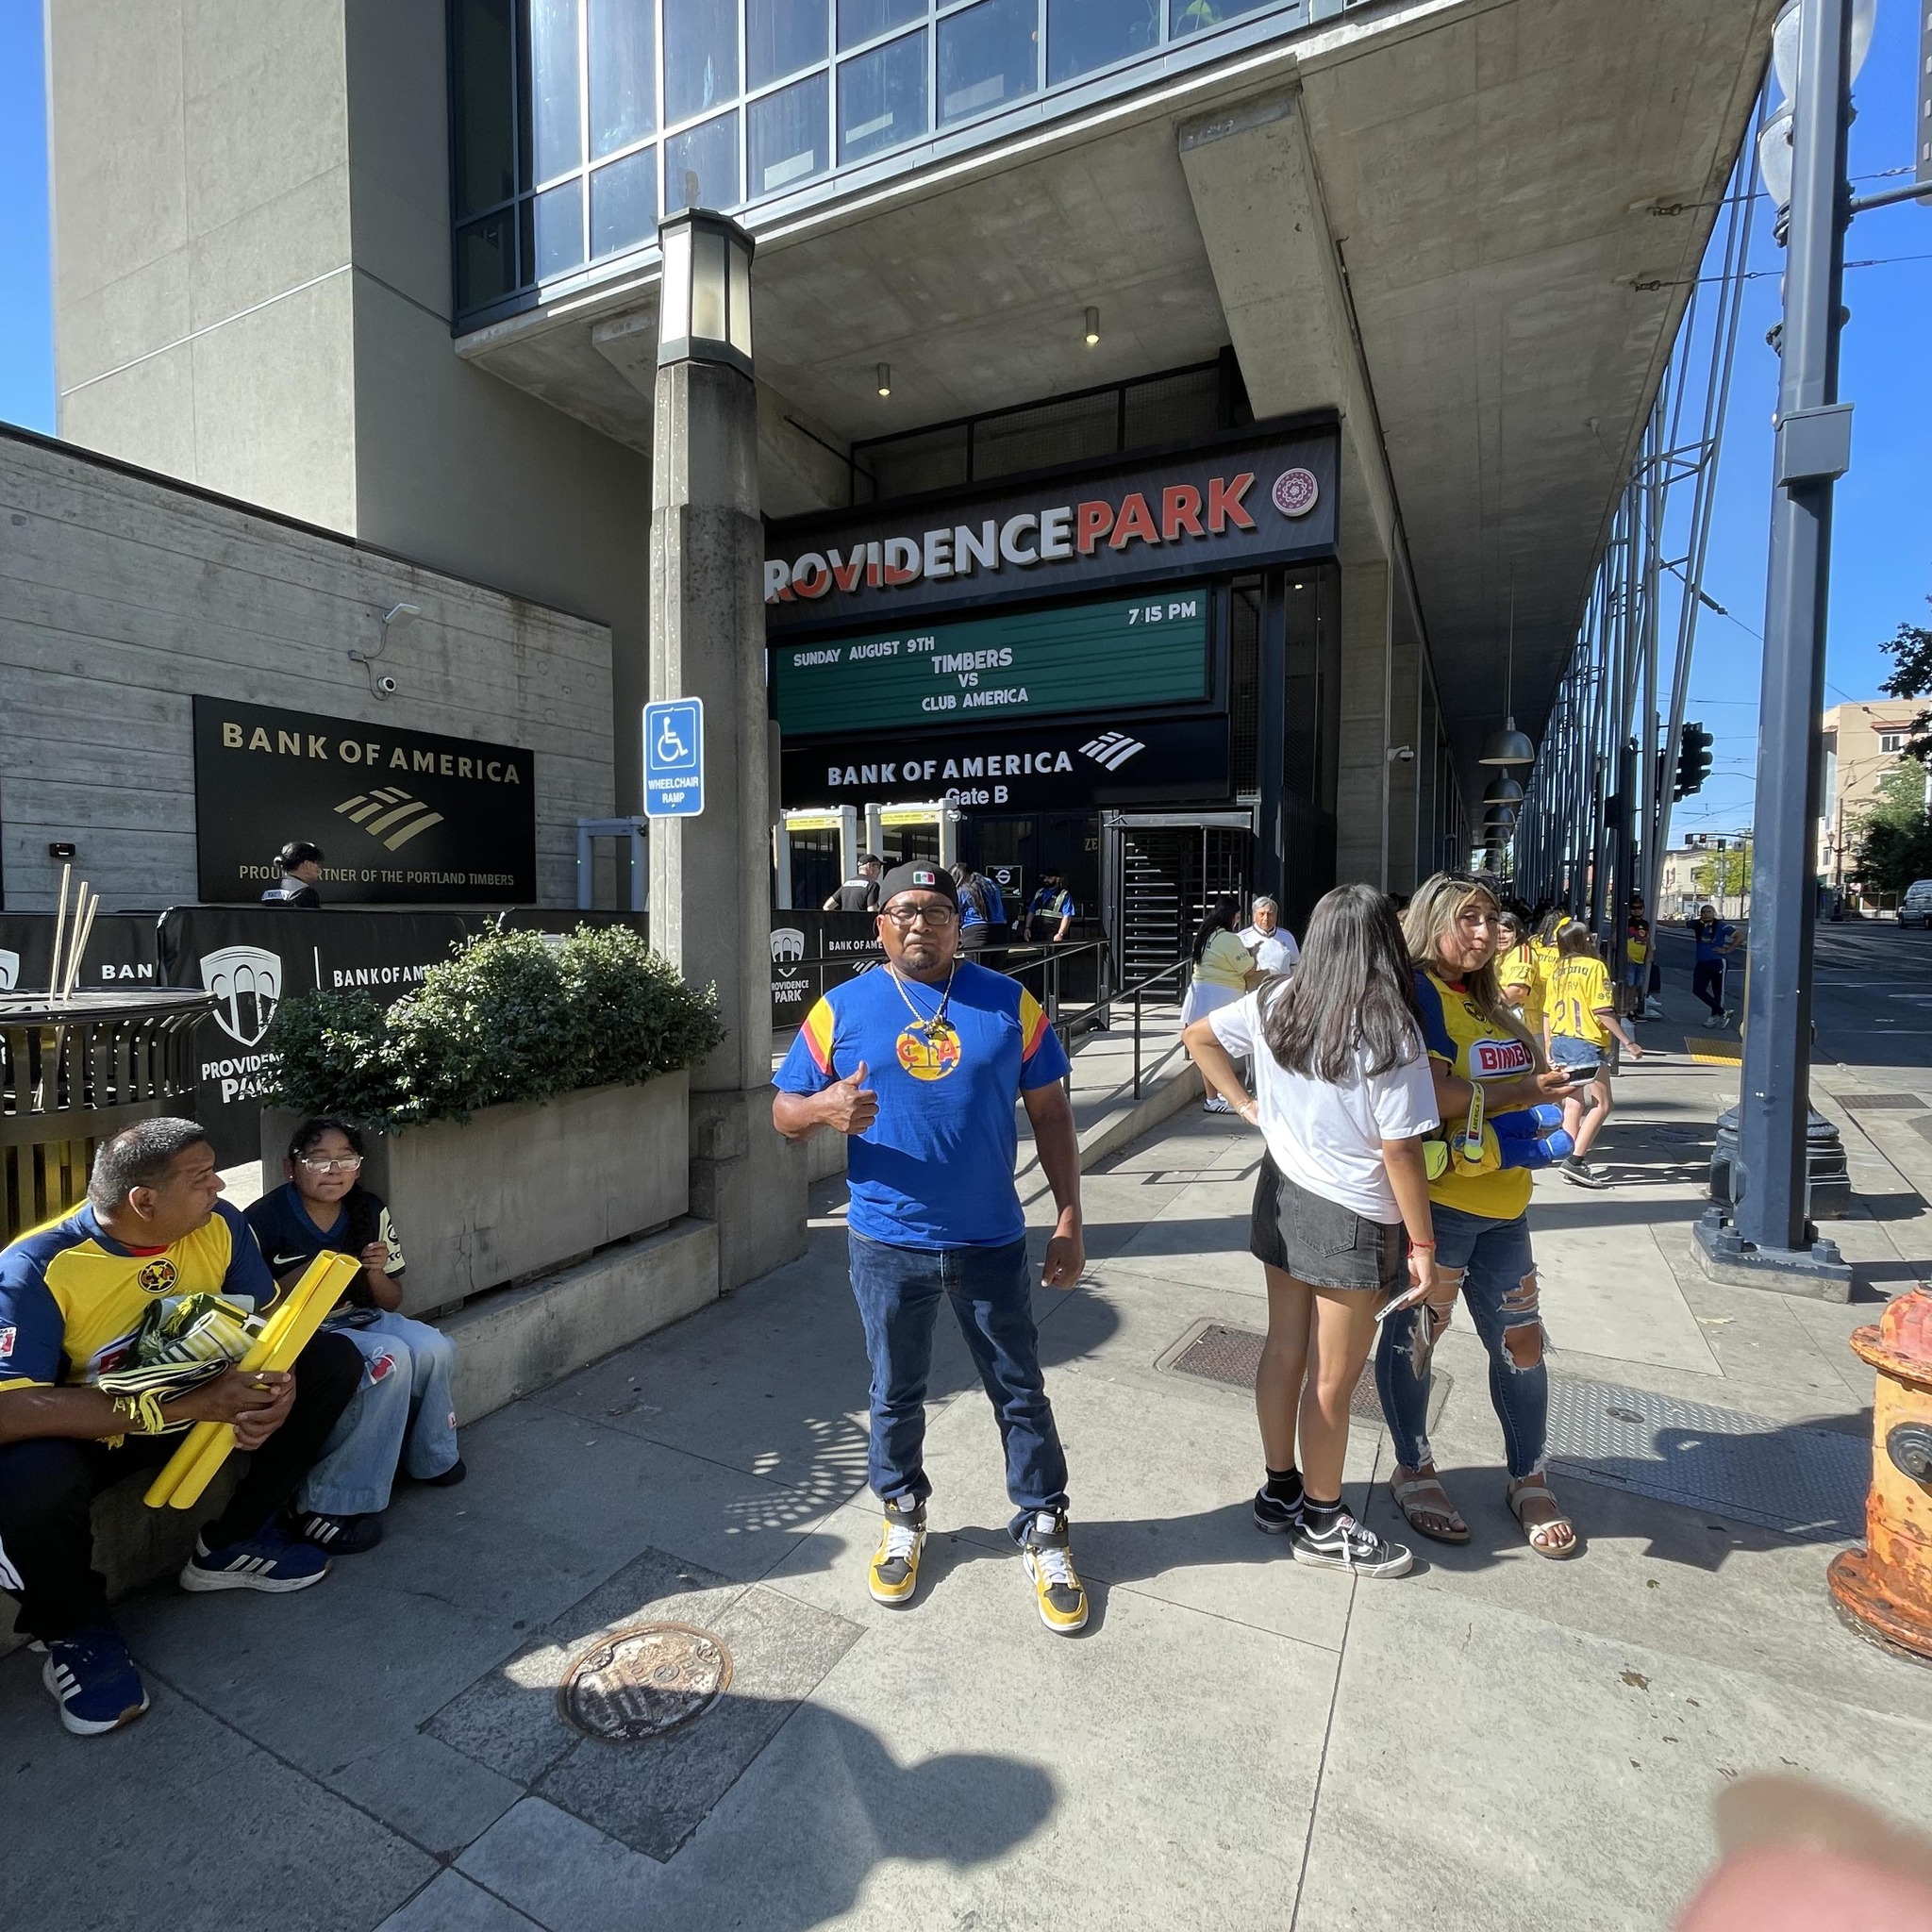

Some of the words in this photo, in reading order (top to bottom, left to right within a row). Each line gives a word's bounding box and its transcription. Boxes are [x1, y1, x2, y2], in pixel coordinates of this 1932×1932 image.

[1168, 601, 1196, 620] PM
[793, 648, 841, 666] SUNDAY
[849, 641, 900, 660] AUGUST
[907, 636, 935, 653] 9TH
[931, 647, 1013, 674] TIMBERS
[958, 672, 978, 688] VS
[922, 694, 957, 711] CLUB
[962, 687, 1029, 708] AMERICA
[223, 722, 327, 759] BANK
[339, 740, 380, 765] OF
[389, 747, 521, 784] AMERICA
[827, 762, 897, 786] BANK
[903, 759, 937, 781] OF
[941, 751, 1074, 779] AMERICA
[648, 776, 699, 790] WHEELCHAIR
[661, 792, 686, 804] RAMP
[945, 787, 990, 806] Gate
[994, 785, 1008, 804] B
[239, 865, 283, 879] PROU
[361, 870, 378, 882] OF
[380, 870, 404, 884] THE
[407, 871, 466, 885] PORTLAND
[470, 873, 515, 886] TIMBERS
[829, 941, 852, 951] BANK
[853, 940, 865, 950] OF
[101, 963, 153, 980] BAN
[333, 968, 379, 988] BANK
[380, 966, 400, 983] OF
[772, 979, 809, 991] ROVIDENCE
[774, 989, 803, 1003] PARK
